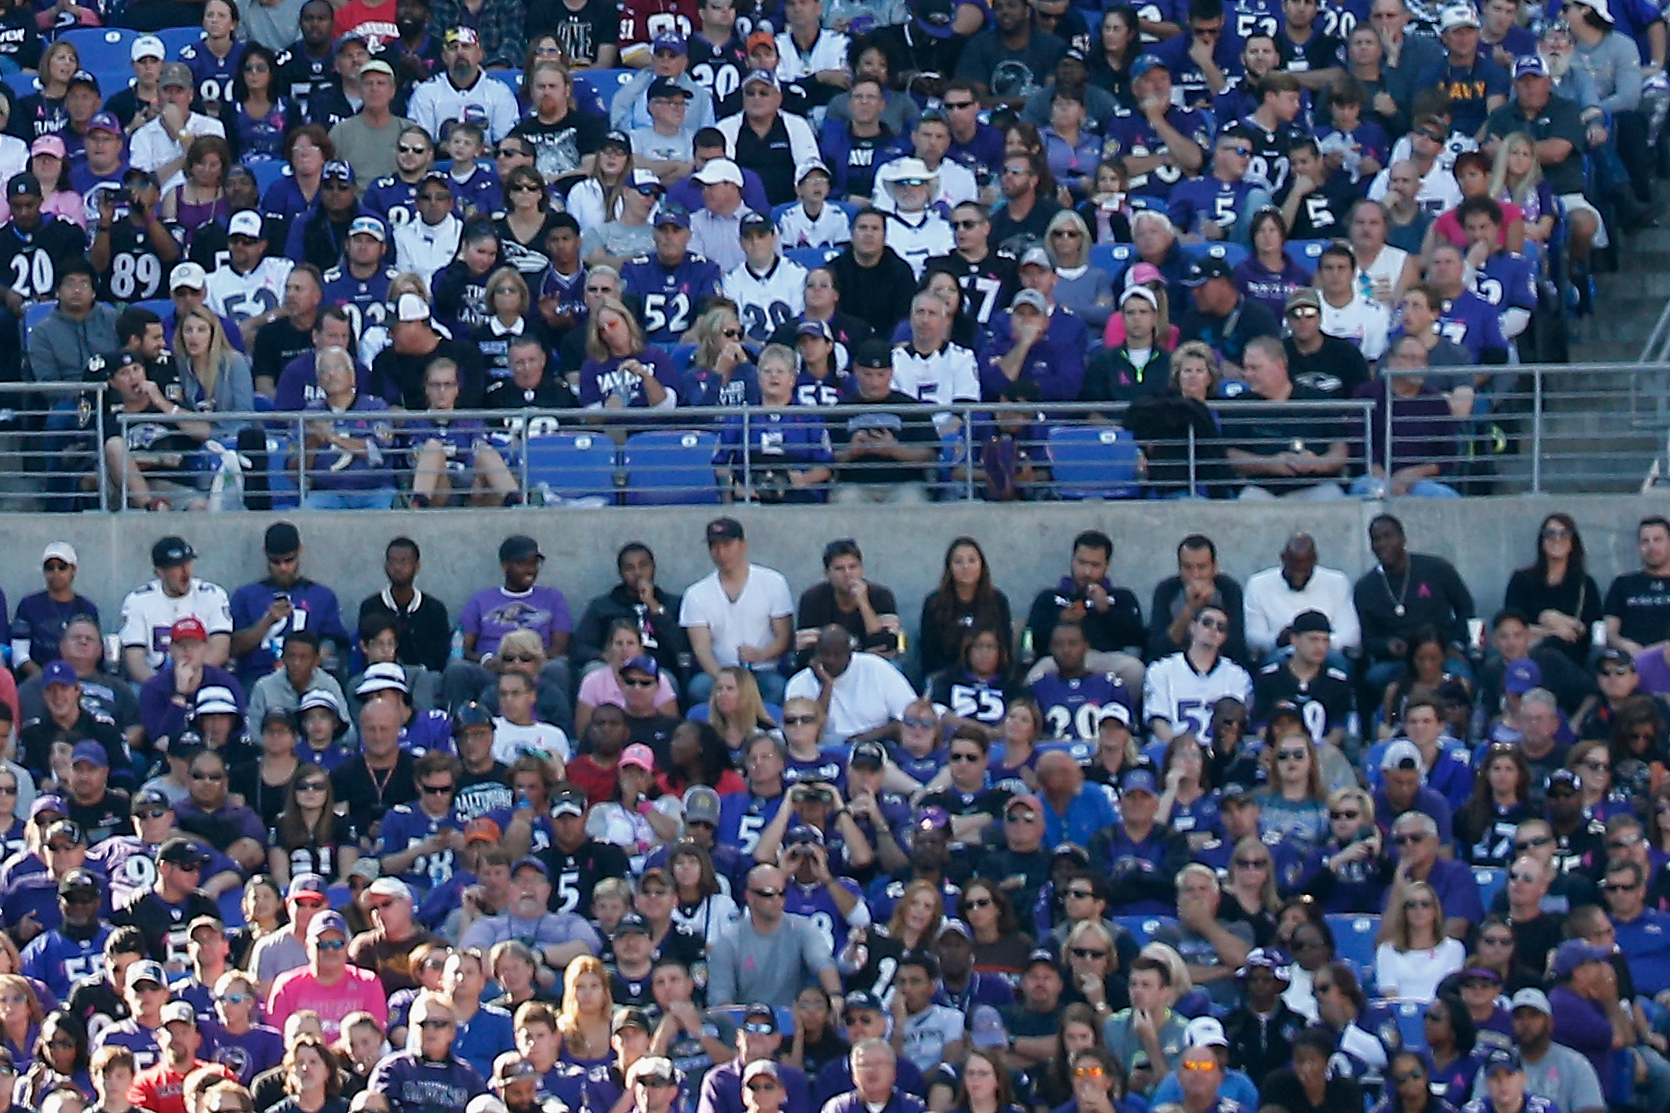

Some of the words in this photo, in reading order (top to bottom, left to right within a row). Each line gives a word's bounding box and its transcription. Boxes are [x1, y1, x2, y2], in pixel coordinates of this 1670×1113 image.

[1216, 196, 1237, 226] 5
[1307, 195, 1335, 228] 5
[9, 249, 53, 295] 20
[110, 253, 162, 296] 89
[644, 294, 690, 332] 52
[961, 279, 1004, 324] 7
[952, 685, 1006, 723] 55
[1048, 703, 1102, 743] 20
[739, 816, 764, 853] 5
[126, 855, 157, 893] 9
[557, 874, 579, 914] 5
